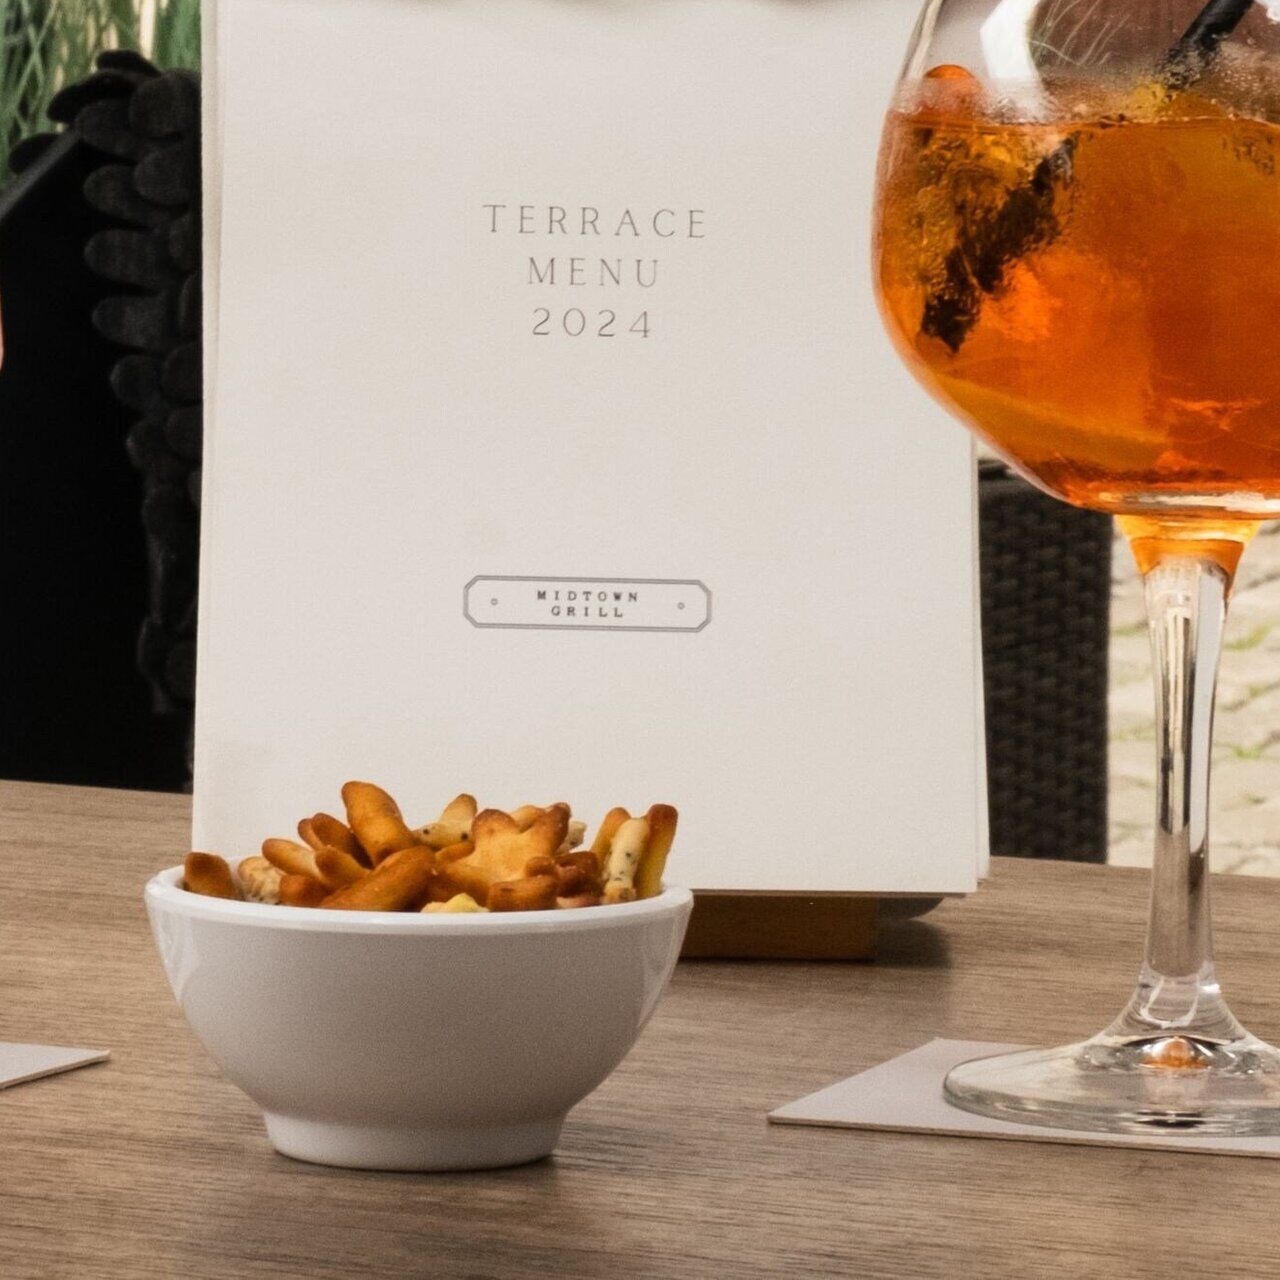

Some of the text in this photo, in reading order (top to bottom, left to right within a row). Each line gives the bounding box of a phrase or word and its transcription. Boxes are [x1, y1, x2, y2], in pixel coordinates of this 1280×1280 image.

[483, 204, 706, 239] TERRACE
[528, 256, 659, 288] MENU
[532, 307, 651, 339] 2024
[536, 589, 638, 603] MIDTOWN
[551, 605, 624, 618] GRILL
